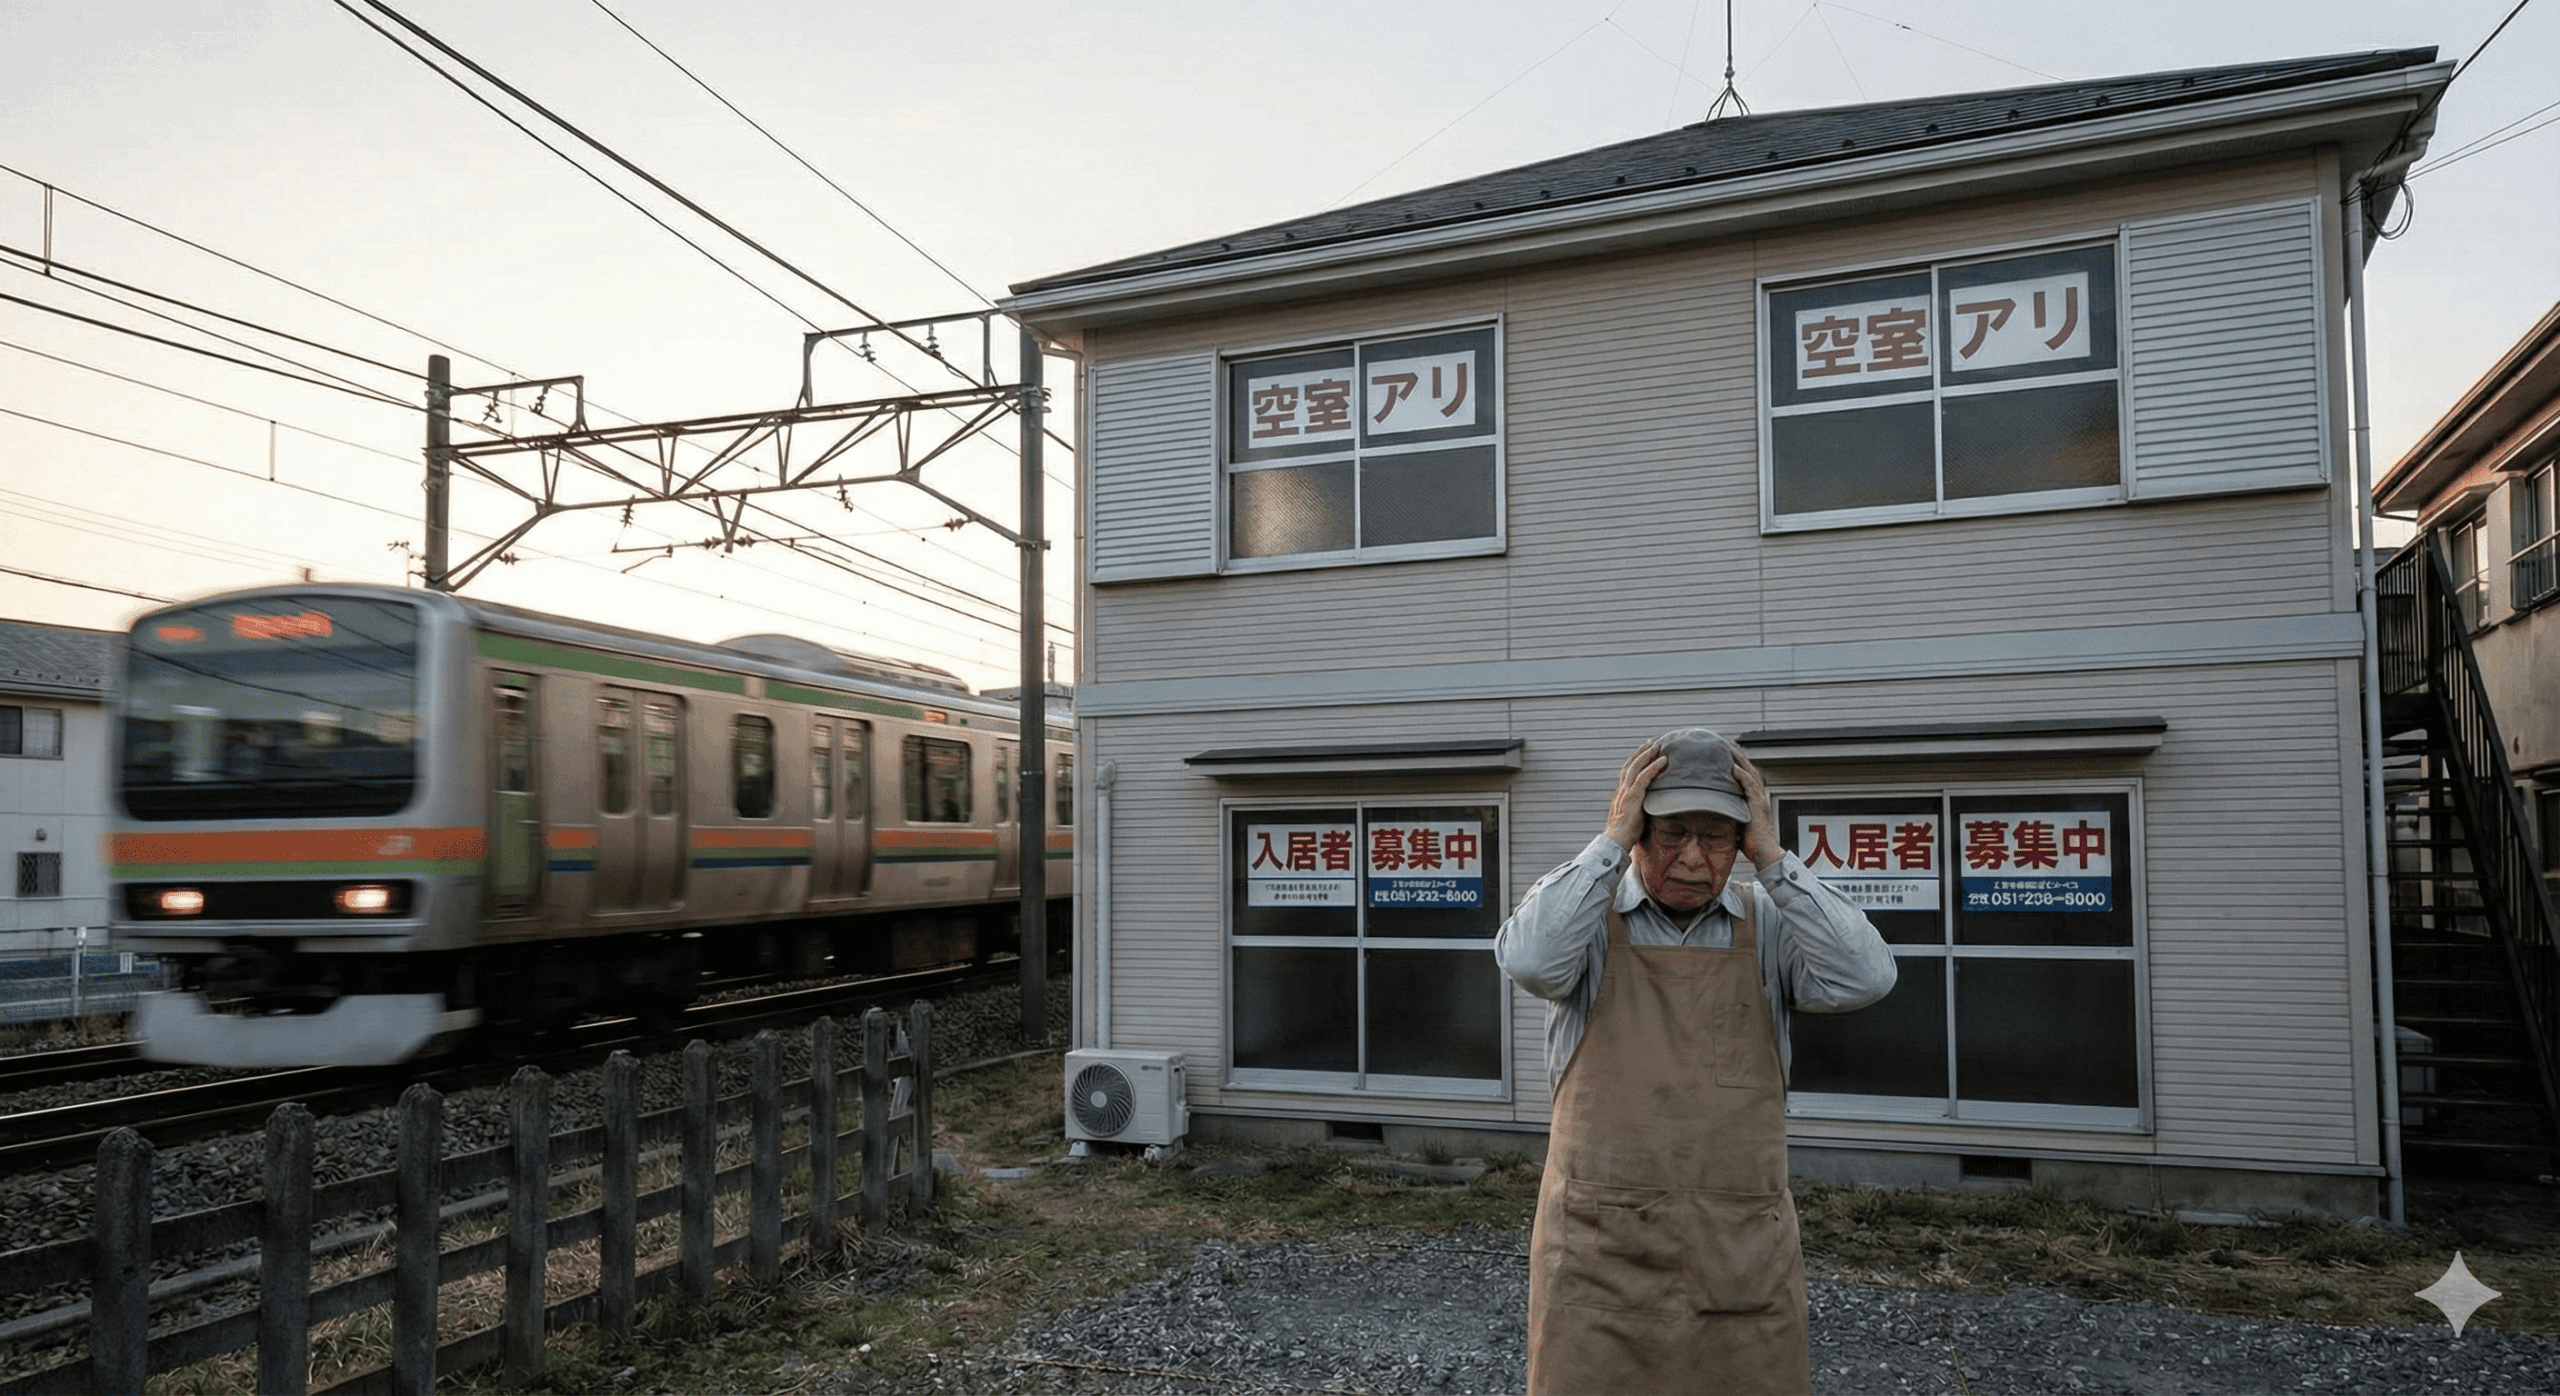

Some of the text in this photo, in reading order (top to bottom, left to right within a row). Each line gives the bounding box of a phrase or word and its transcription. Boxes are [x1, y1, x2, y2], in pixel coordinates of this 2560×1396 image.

[1804, 286, 2078, 378] 空室 アリ
[1252, 362, 1468, 439] 空室 アリ
[1251, 828, 1478, 871] 入居者 募集中
[1803, 820, 2106, 870] 入居者 募集中
